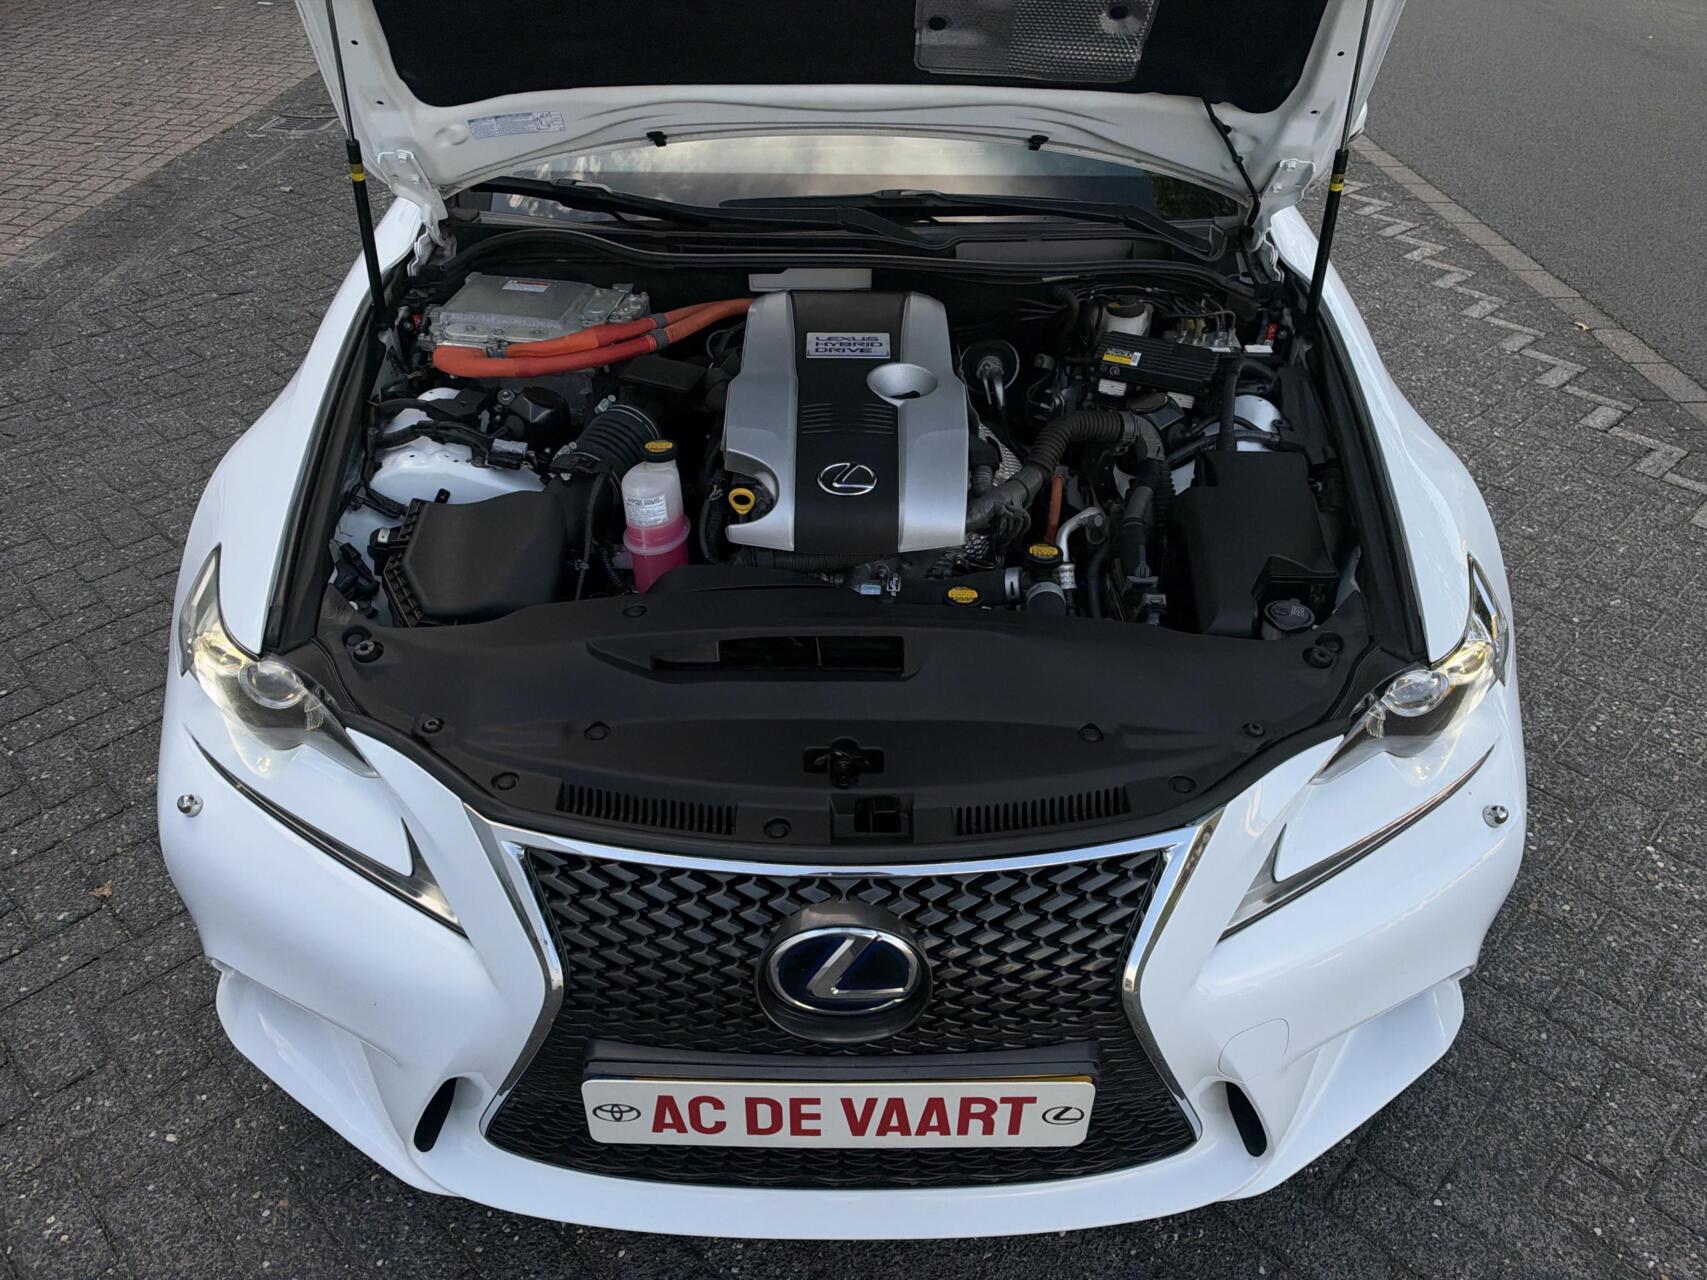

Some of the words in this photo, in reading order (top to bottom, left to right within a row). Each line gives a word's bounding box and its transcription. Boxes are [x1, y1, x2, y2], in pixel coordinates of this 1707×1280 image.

[651, 1095, 727, 1135] AC
[744, 1096, 822, 1136] DE
[839, 1096, 1038, 1137] VAART
